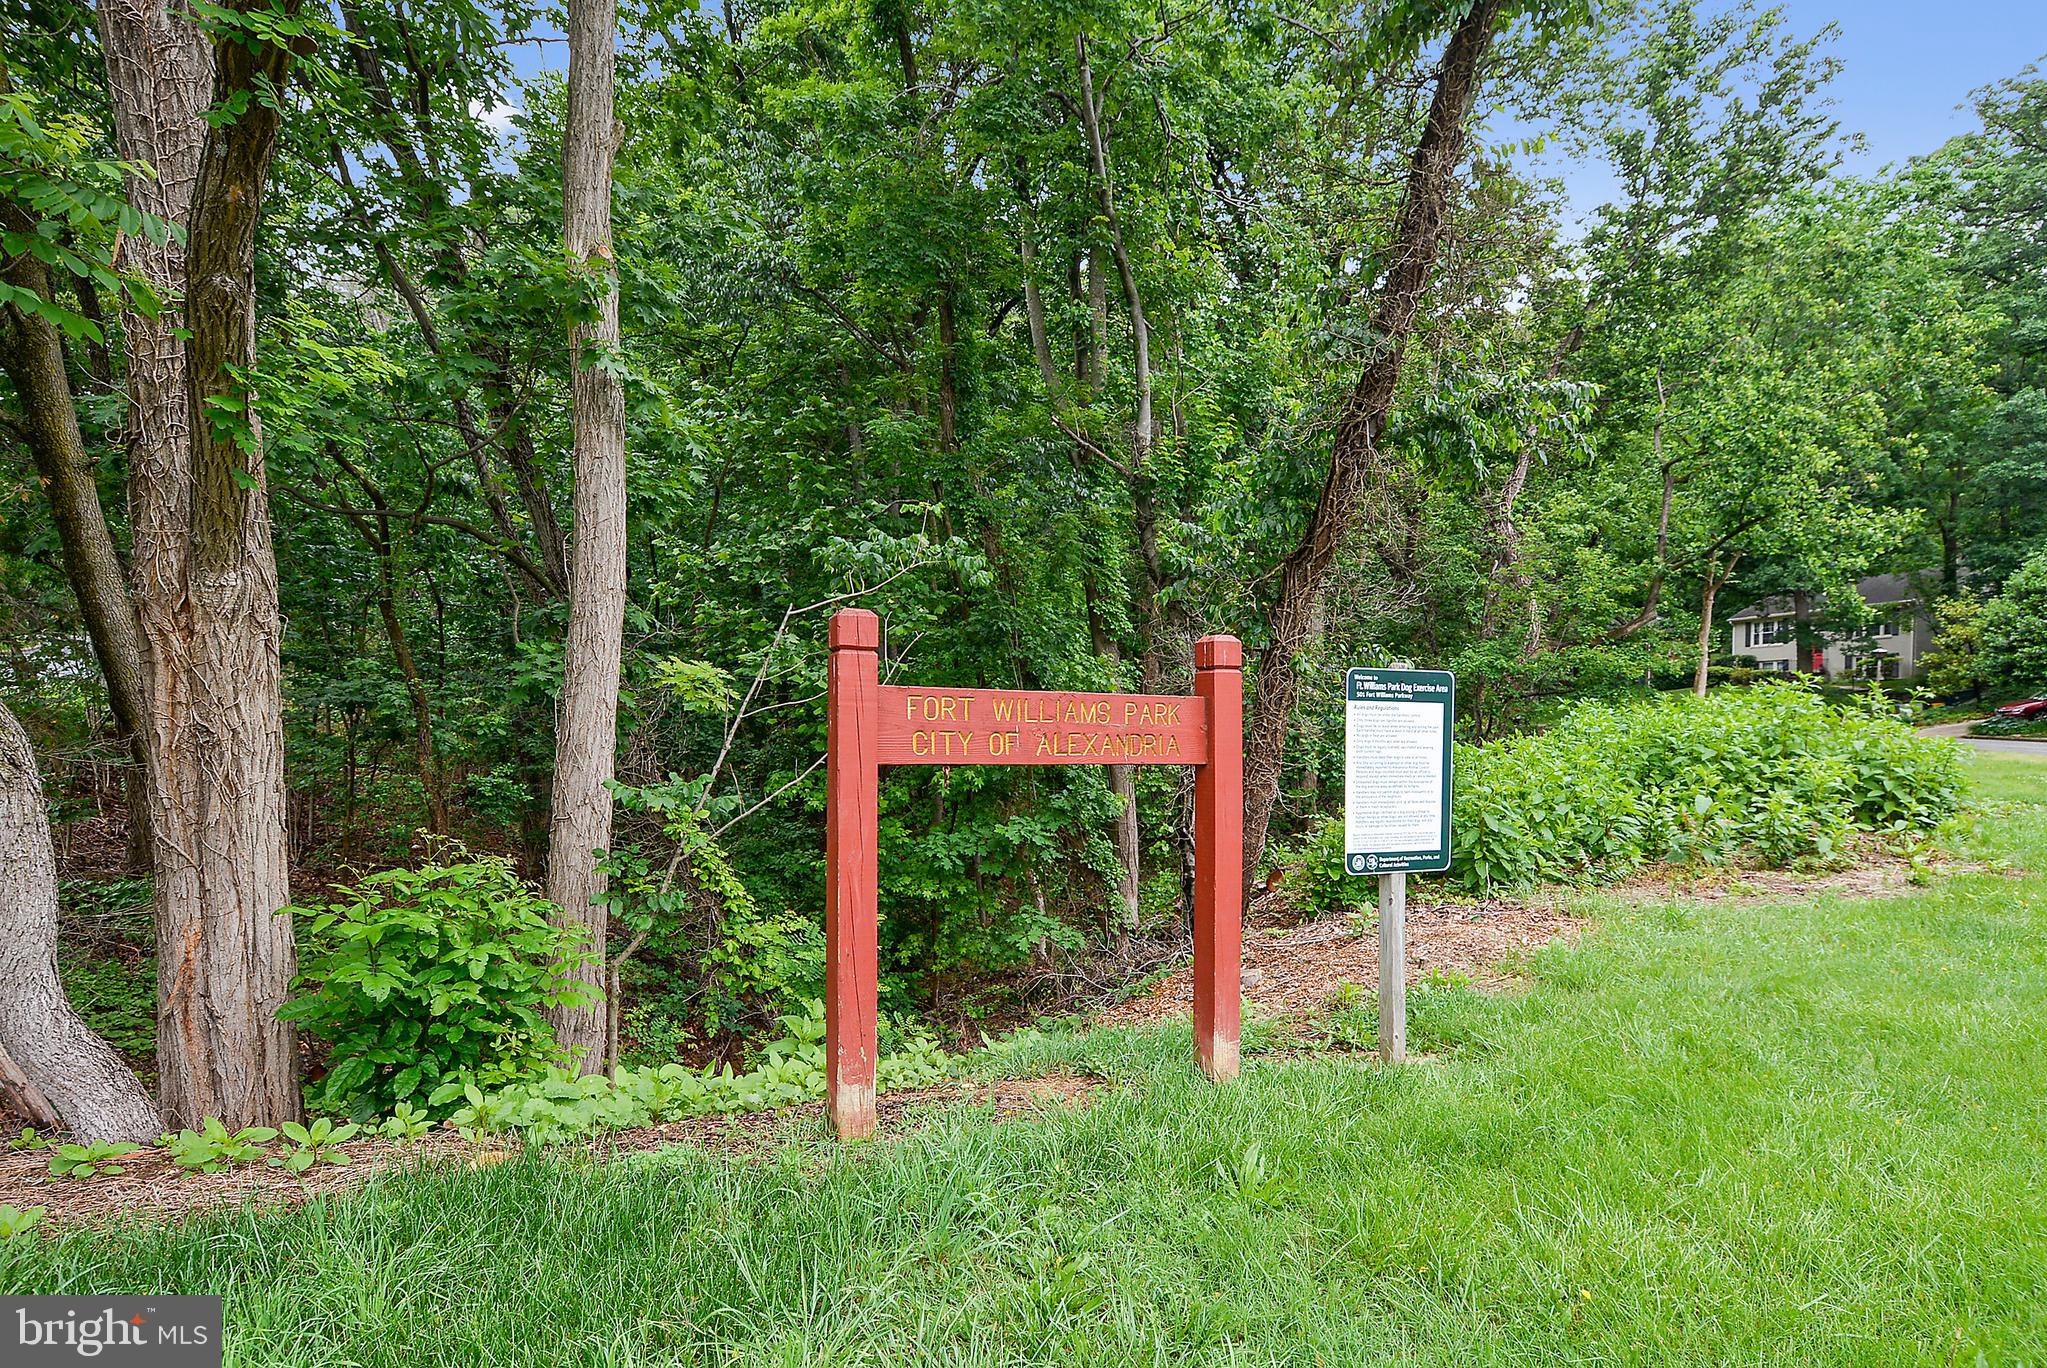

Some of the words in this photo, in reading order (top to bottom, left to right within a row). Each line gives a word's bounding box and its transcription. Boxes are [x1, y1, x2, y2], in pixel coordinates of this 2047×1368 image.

[1363, 682, 1387, 691] Williams
[1387, 682, 1400, 691] Park
[1401, 683, 1412, 693] Dog
[1413, 683, 1435, 692] Exercise
[1436, 684, 1449, 693] Area
[906, 695, 976, 721] FORT
[993, 698, 1111, 725] WILLIAMS
[1124, 701, 1181, 726] PARK
[912, 731, 973, 756] CITY
[989, 731, 1018, 756] OF
[1036, 732, 1181, 757] ALEXANDRIA
